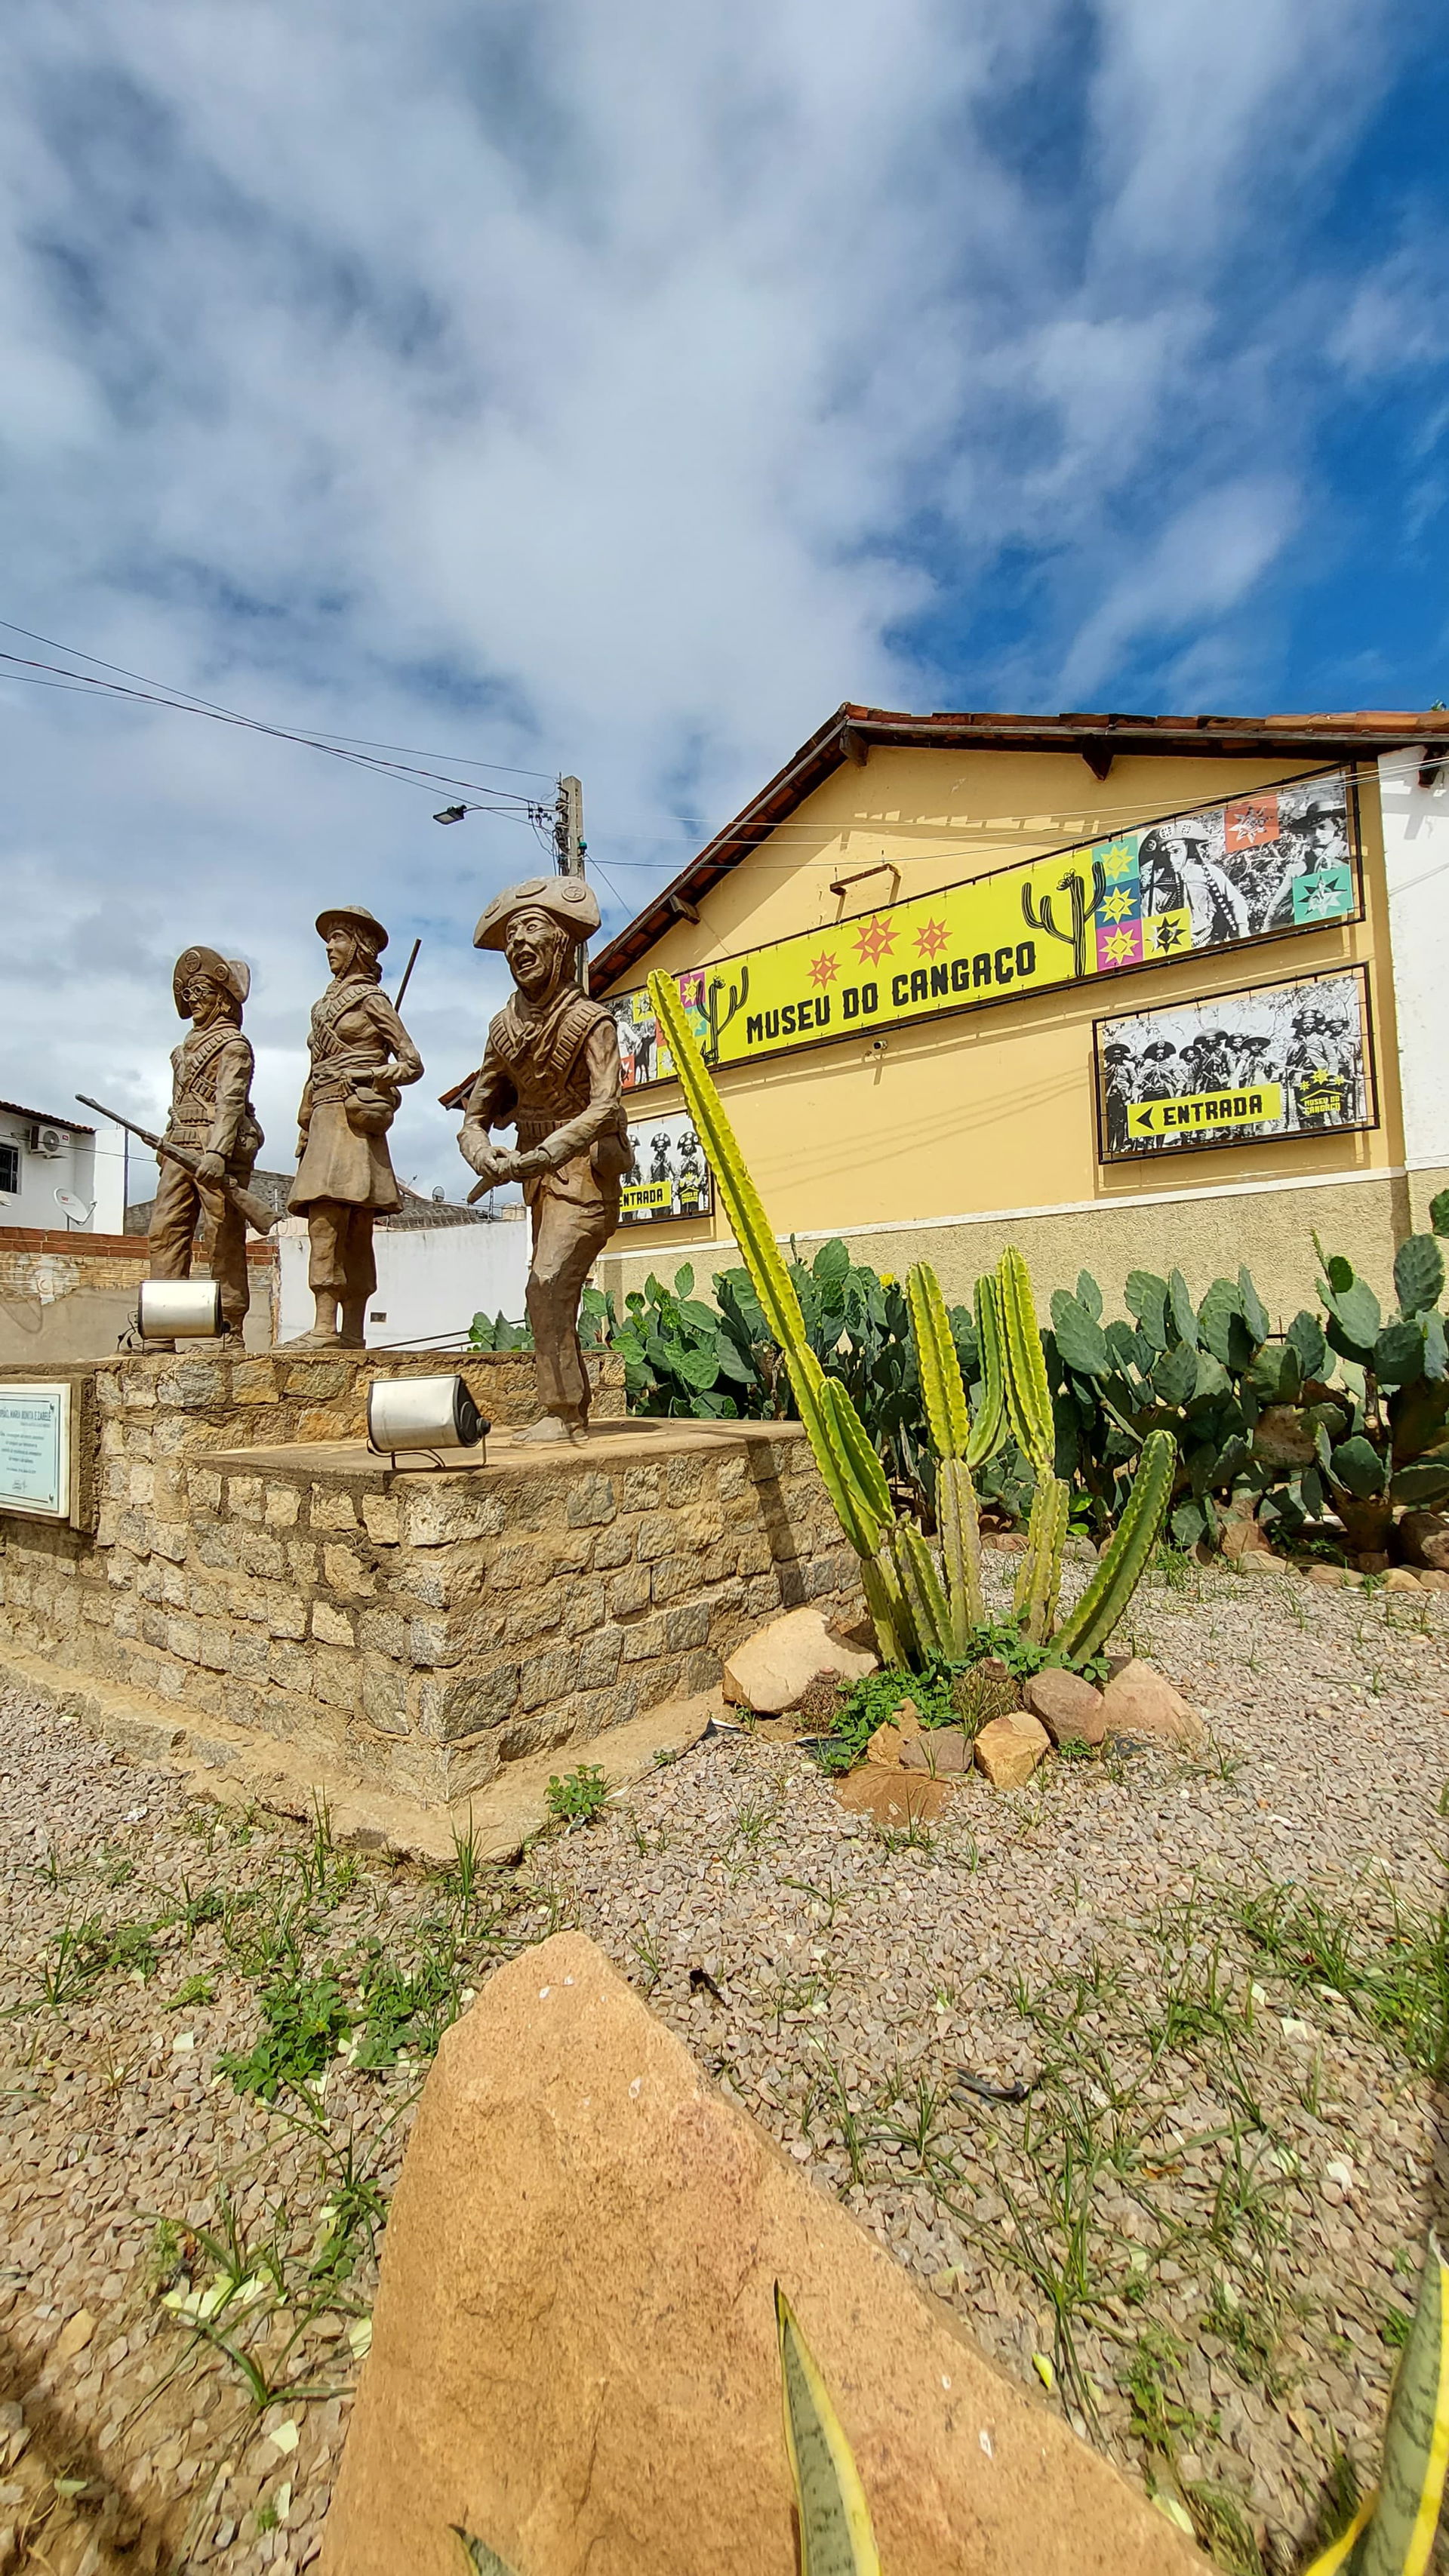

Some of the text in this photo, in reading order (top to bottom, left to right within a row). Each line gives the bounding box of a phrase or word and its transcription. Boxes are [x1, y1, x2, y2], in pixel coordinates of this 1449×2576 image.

[746, 941, 1036, 1045] MUSEU DO CANGAÇO
[1163, 1094, 1263, 1126] ENTRADA
